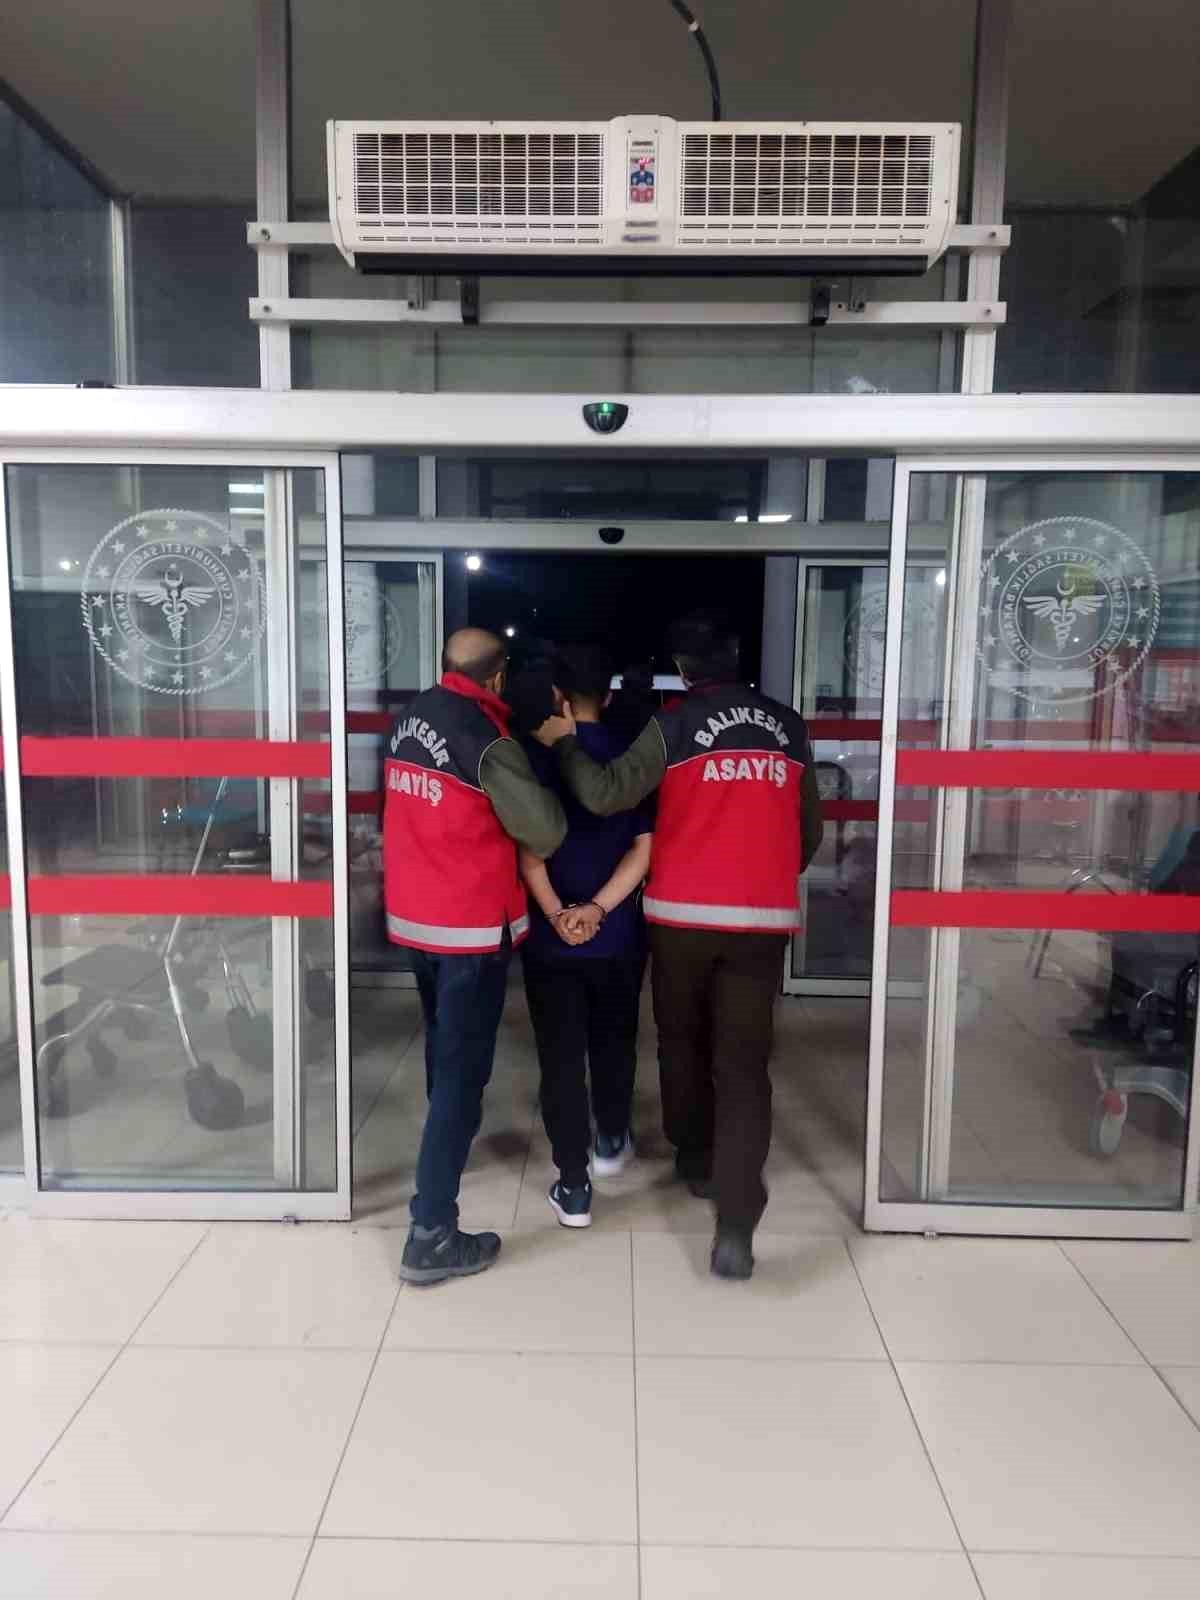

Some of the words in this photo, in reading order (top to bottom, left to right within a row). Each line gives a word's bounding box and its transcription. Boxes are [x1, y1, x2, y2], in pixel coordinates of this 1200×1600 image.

[390, 716, 450, 768] BALIKESİR
[694, 707, 790, 748] BALIKESİR
[702, 755, 788, 788] ASAYİŞ
